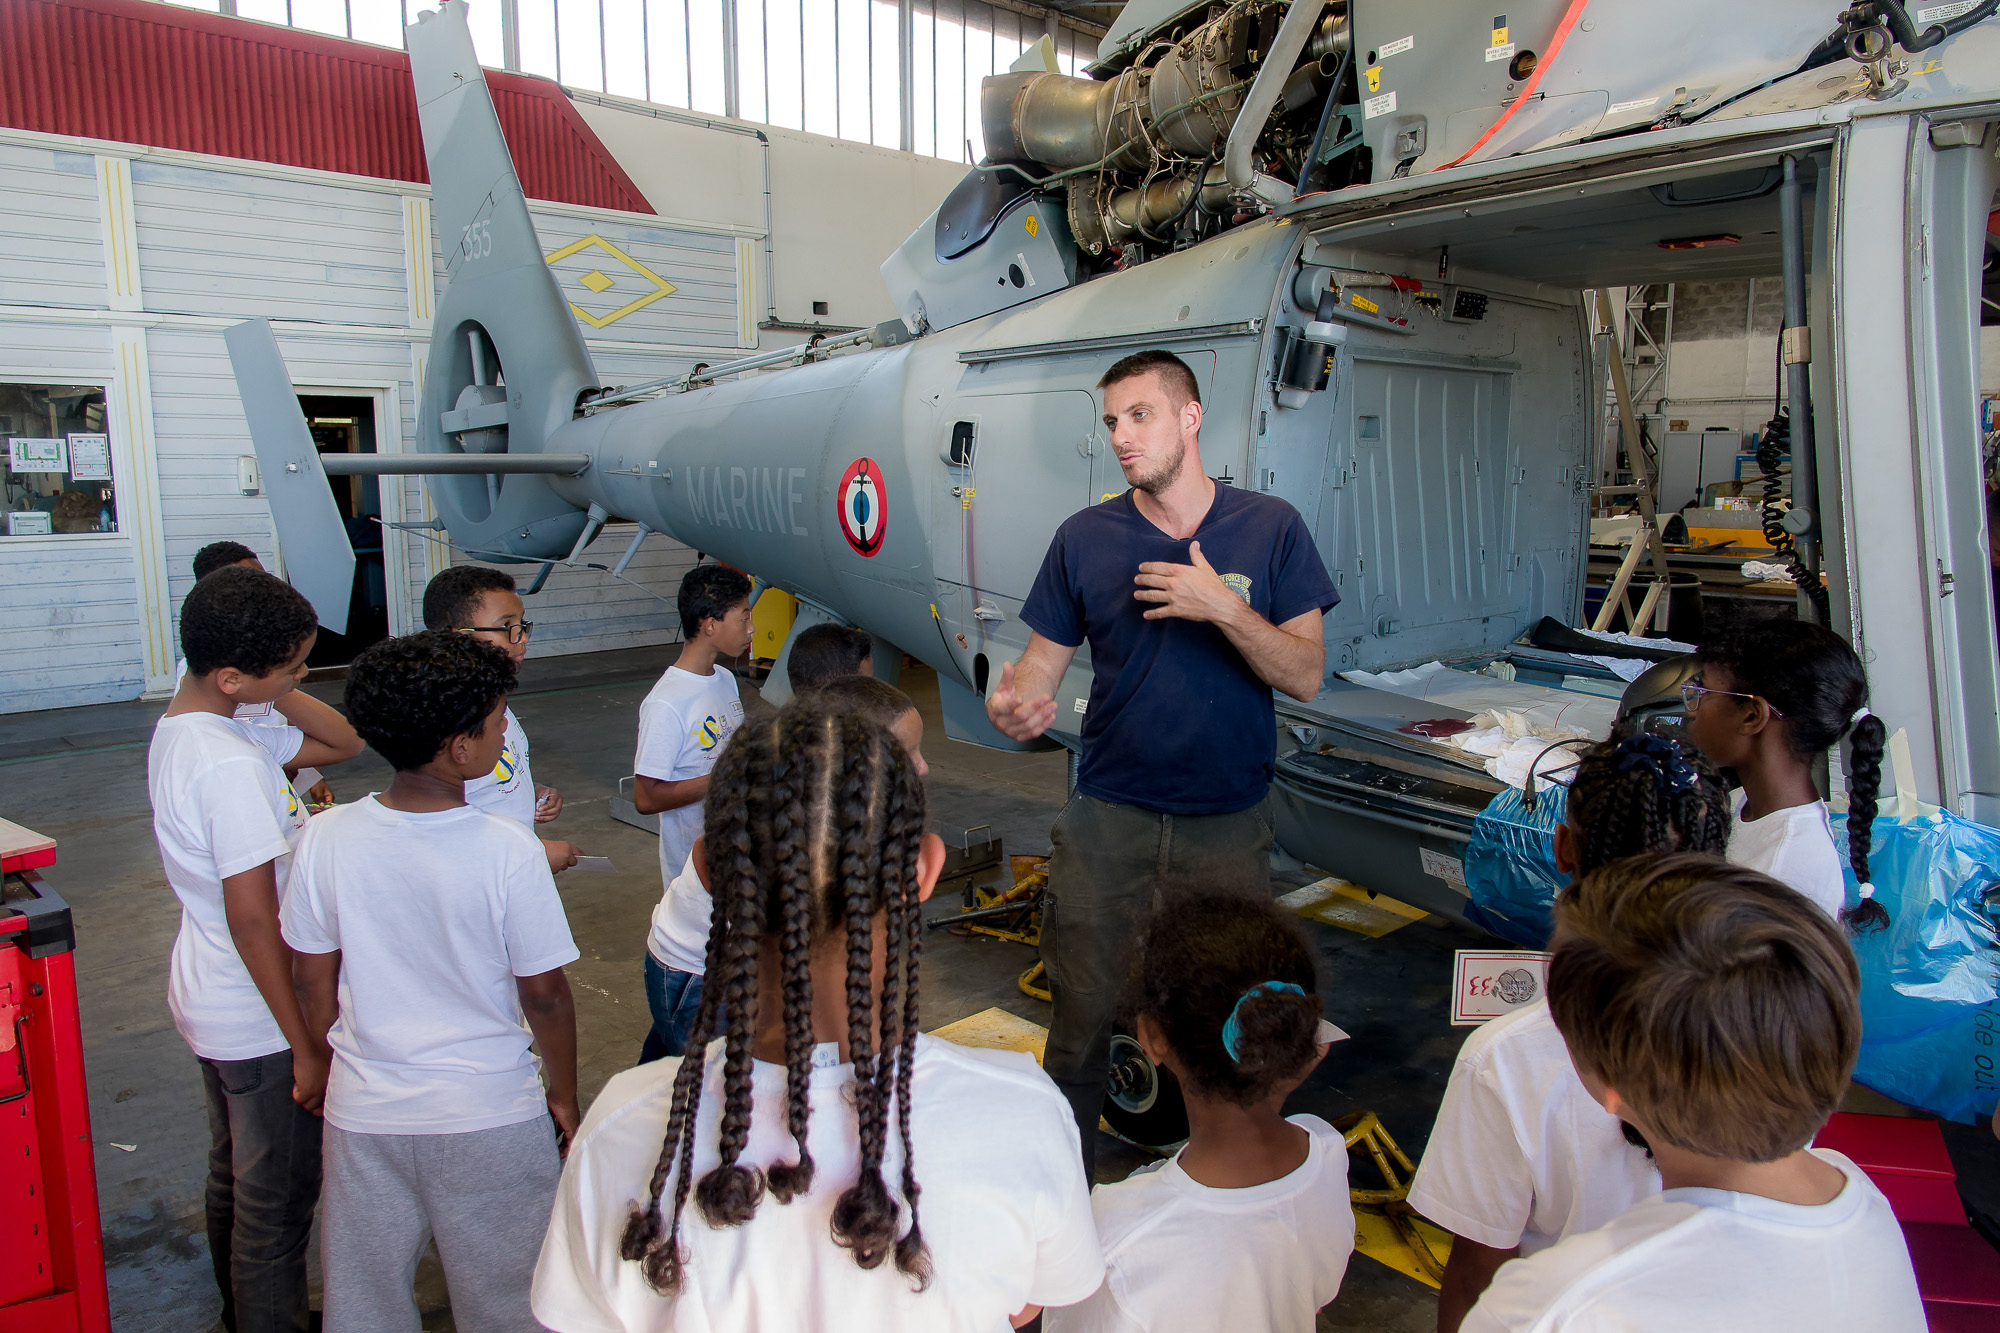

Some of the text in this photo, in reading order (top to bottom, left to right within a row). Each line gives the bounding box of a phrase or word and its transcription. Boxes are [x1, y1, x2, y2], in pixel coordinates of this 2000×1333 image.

[462, 220, 491, 262] 355
[686, 466, 808, 537] MARINE
[1974, 1054, 1999, 1091] out
